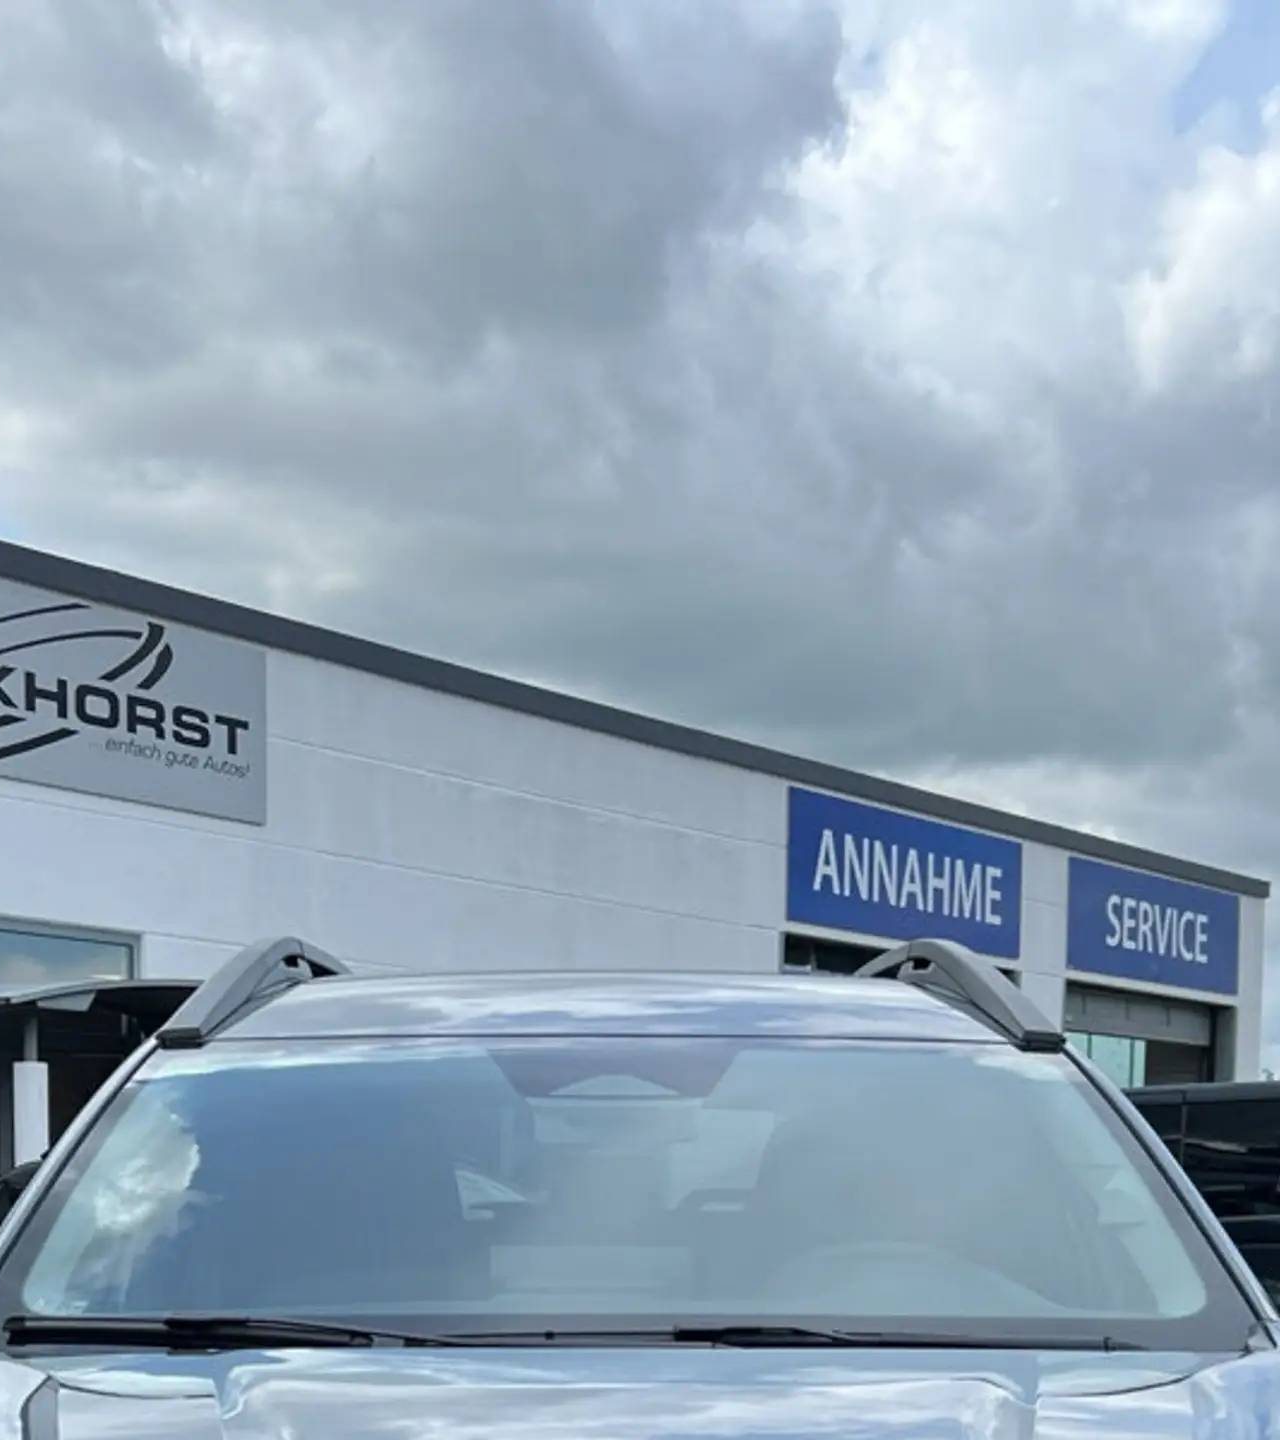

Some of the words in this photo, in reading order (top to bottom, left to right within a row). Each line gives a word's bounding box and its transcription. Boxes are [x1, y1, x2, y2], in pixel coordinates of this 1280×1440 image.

[165, 750, 199, 770] gute
[812, 828, 1003, 926] ANNAHME
[1106, 893, 1209, 964] SERVICE
